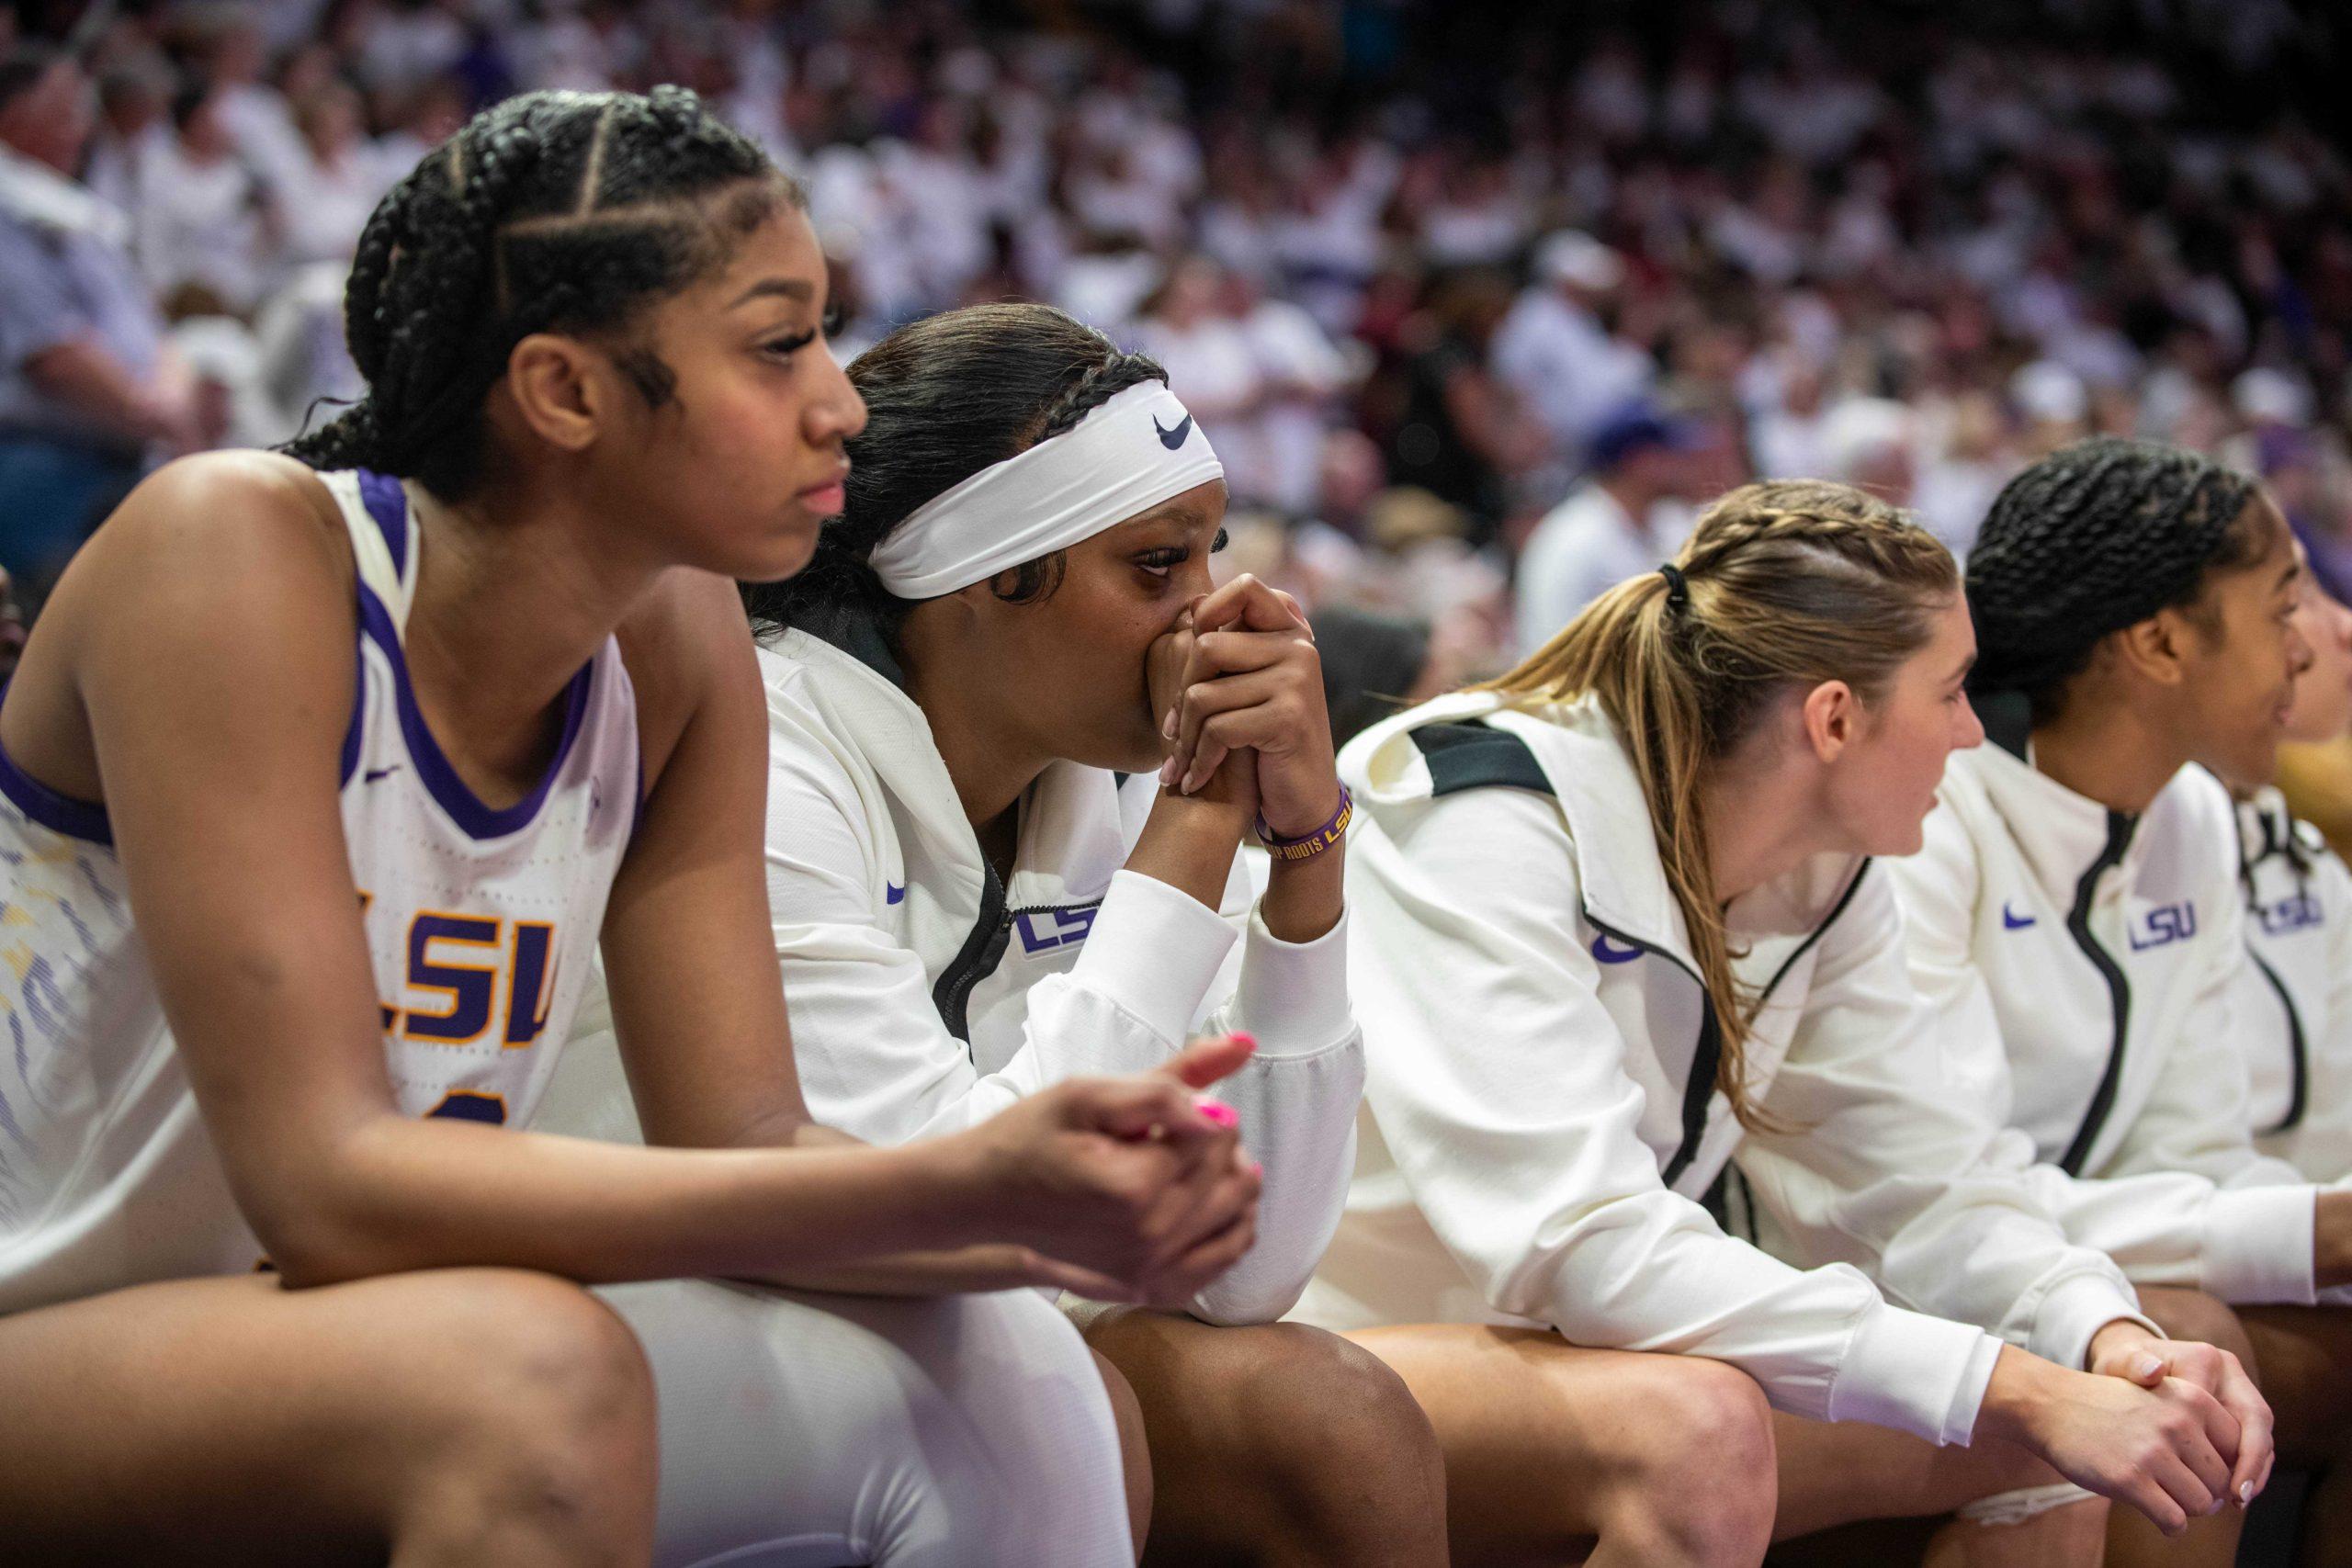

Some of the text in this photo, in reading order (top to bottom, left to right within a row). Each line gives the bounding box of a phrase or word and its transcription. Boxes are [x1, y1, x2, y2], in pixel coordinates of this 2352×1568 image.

[1283, 837, 1324, 860] ROOTS
[1324, 800, 1352, 844] LSU
[1015, 908, 1099, 953] LS
[2128, 900, 2198, 951] LSU
[355, 888, 557, 1049] SU
